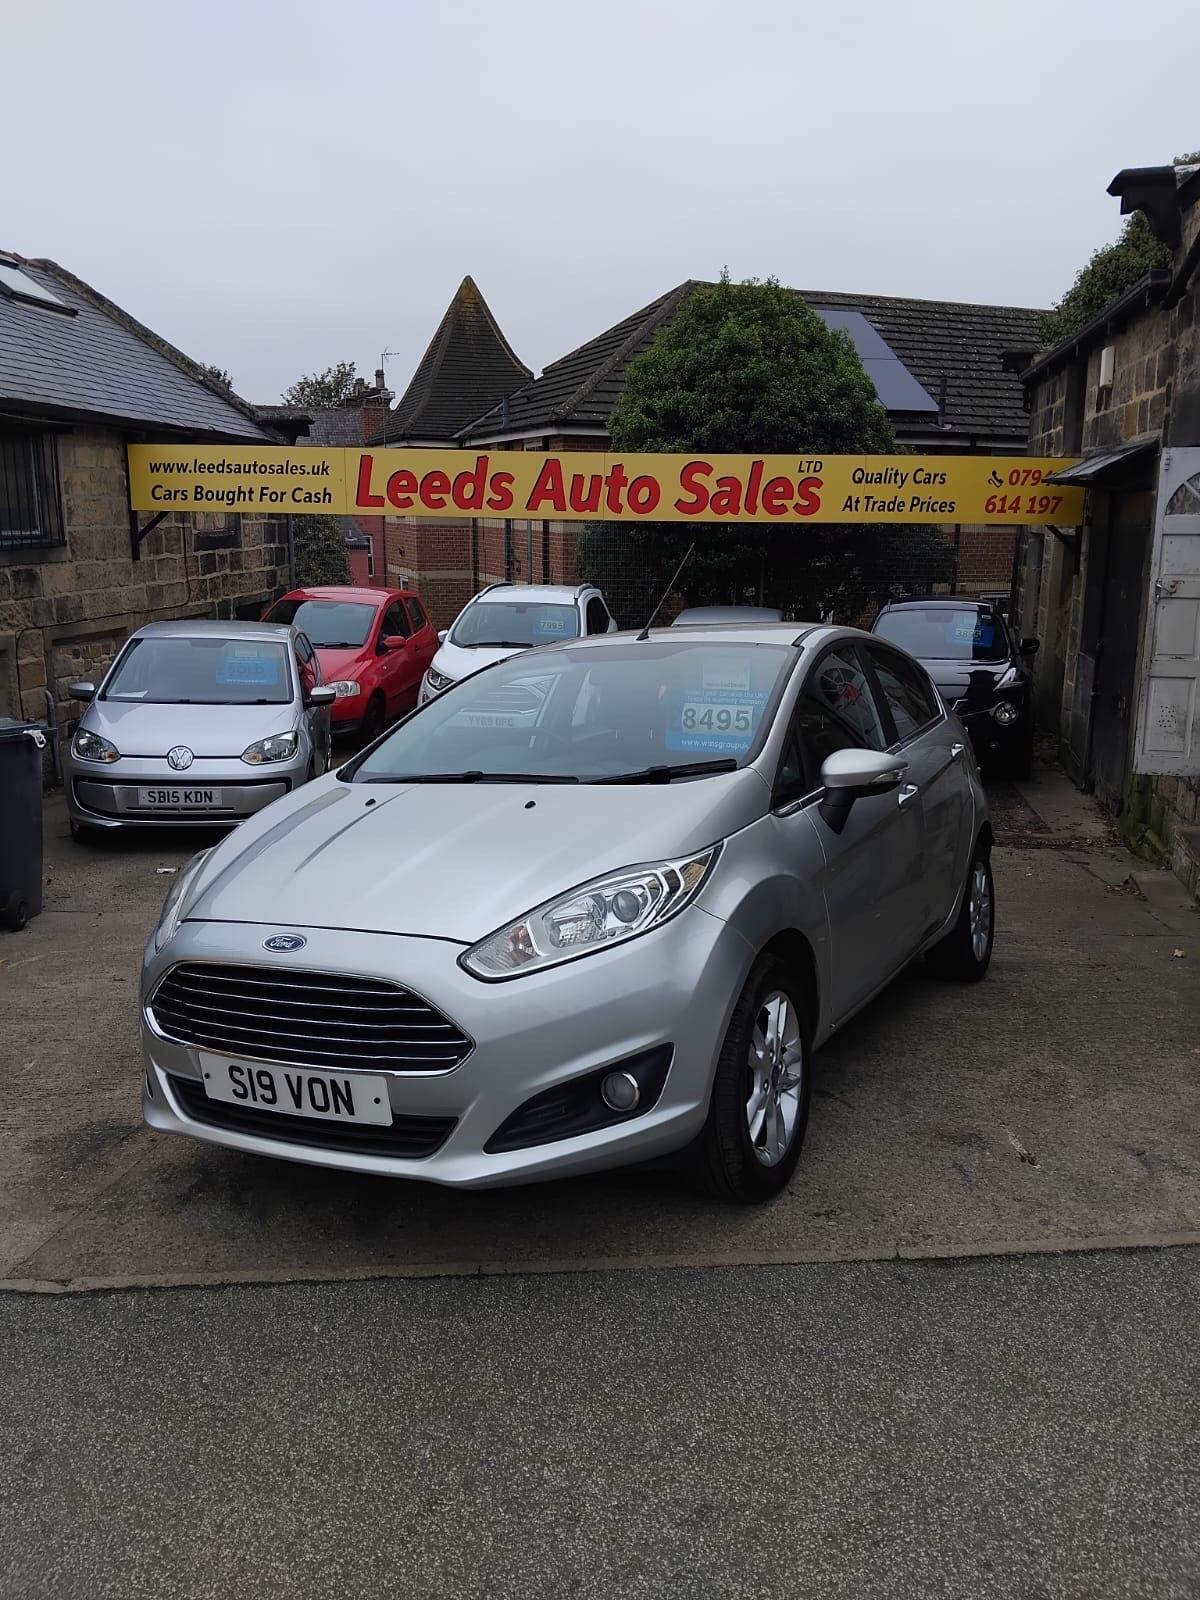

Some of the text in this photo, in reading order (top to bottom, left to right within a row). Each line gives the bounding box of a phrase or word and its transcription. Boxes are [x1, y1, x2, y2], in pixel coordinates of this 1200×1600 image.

[149, 458, 330, 476] www.leedsautosales.uk
[797, 460, 823, 473] LTD
[356, 454, 825, 519] Leeds Auto Sales
[851, 467, 948, 489] Quality Cars
[151, 484, 333, 507] Cars Bought For Cash
[842, 495, 956, 513] At Trade Prices
[984, 495, 1064, 514] 614 197
[683, 708, 751, 731] 8495
[147, 790, 213, 804] SB15 KDN
[270, 936, 296, 948] Ford
[228, 1064, 356, 1117] S19 VON
